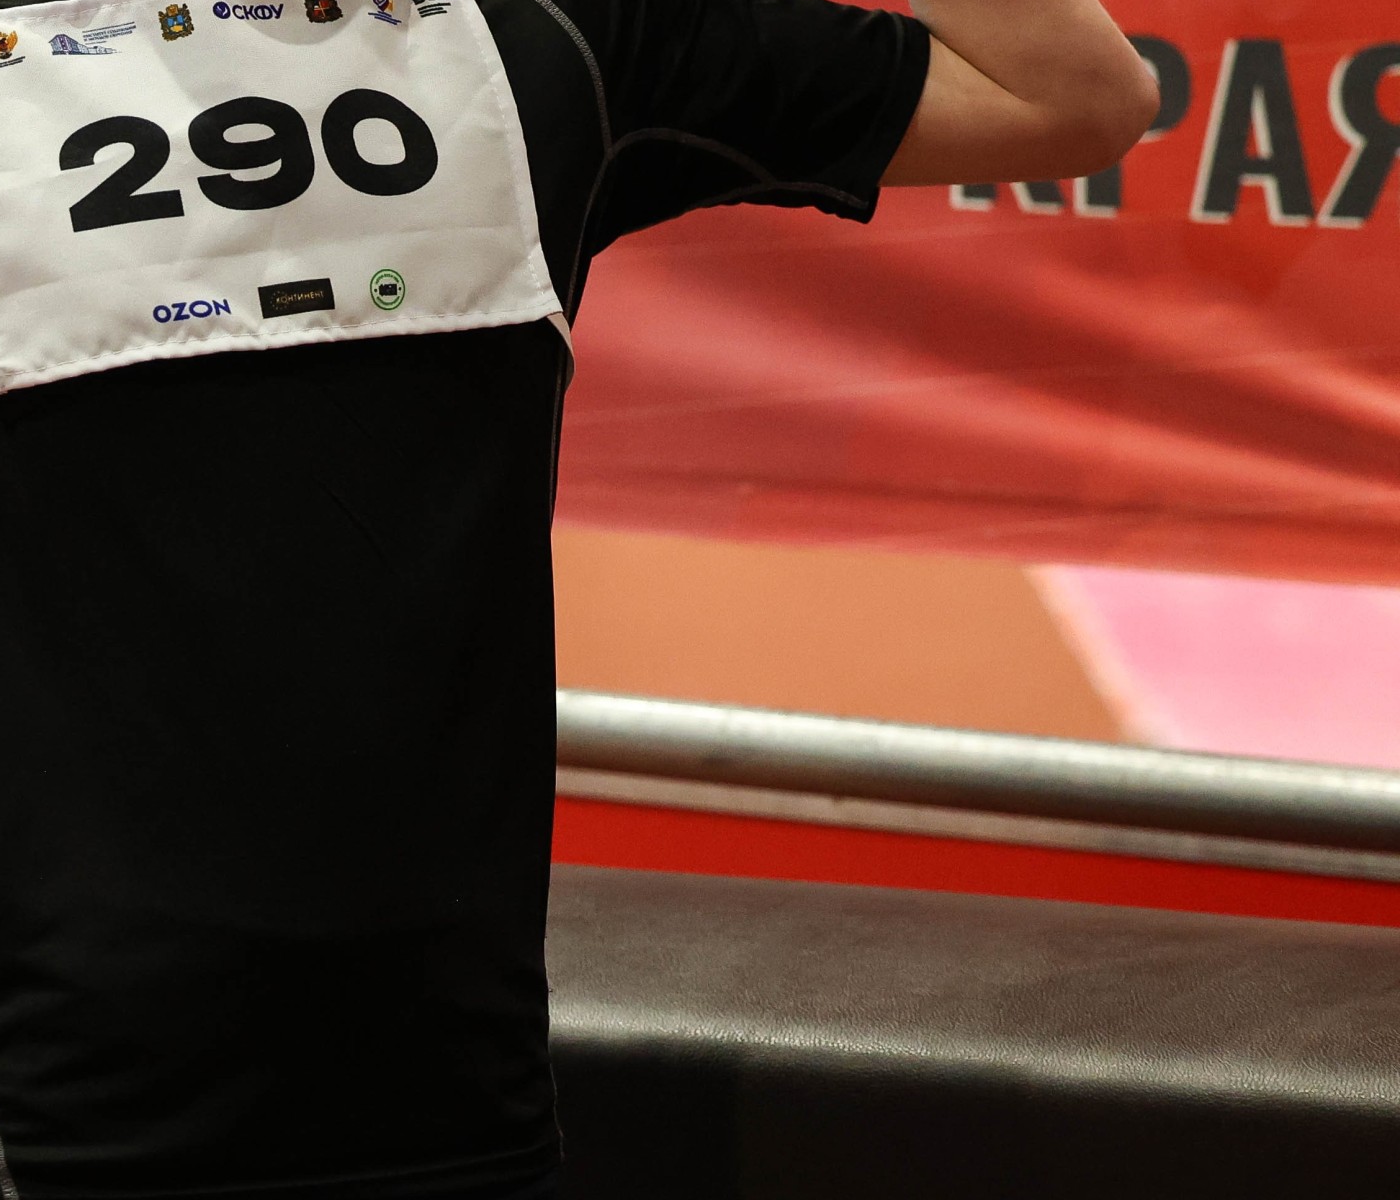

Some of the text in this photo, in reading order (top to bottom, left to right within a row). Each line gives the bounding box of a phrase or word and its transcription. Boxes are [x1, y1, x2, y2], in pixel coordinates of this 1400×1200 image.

[232, 3, 284, 21] СКФУ
[59, 88, 438, 232] 290
[152, 298, 232, 323] OZON
